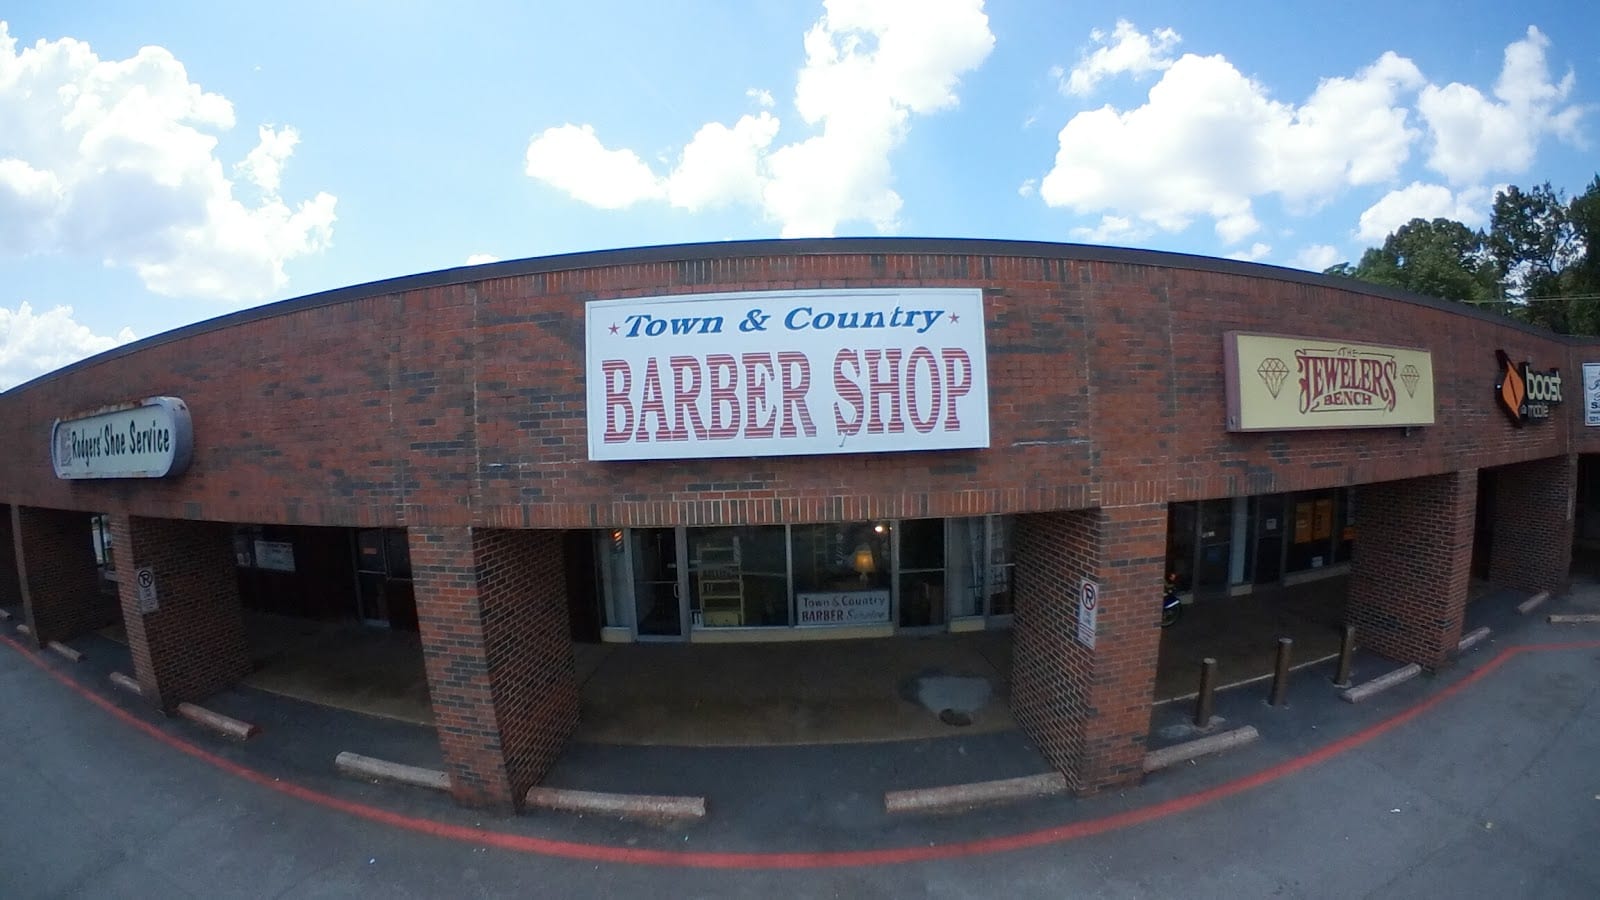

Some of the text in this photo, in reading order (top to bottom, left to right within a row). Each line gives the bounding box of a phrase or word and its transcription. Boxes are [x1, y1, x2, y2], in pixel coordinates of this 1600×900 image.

[625, 305, 945, 338] Town & Country
[602, 346, 973, 444] BARBER SHOP
[1298, 355, 1396, 414] JEWELERS
[1324, 390, 1372, 406] BENCH
[1525, 365, 1562, 402] boost
[72, 428, 102, 467] Rodgers'
[104, 423, 126, 457] Shoe
[129, 419, 170, 455] Service
[802, 610, 844, 622] BARBER
[803, 597, 830, 608] Town
[841, 595, 885, 606] Country
